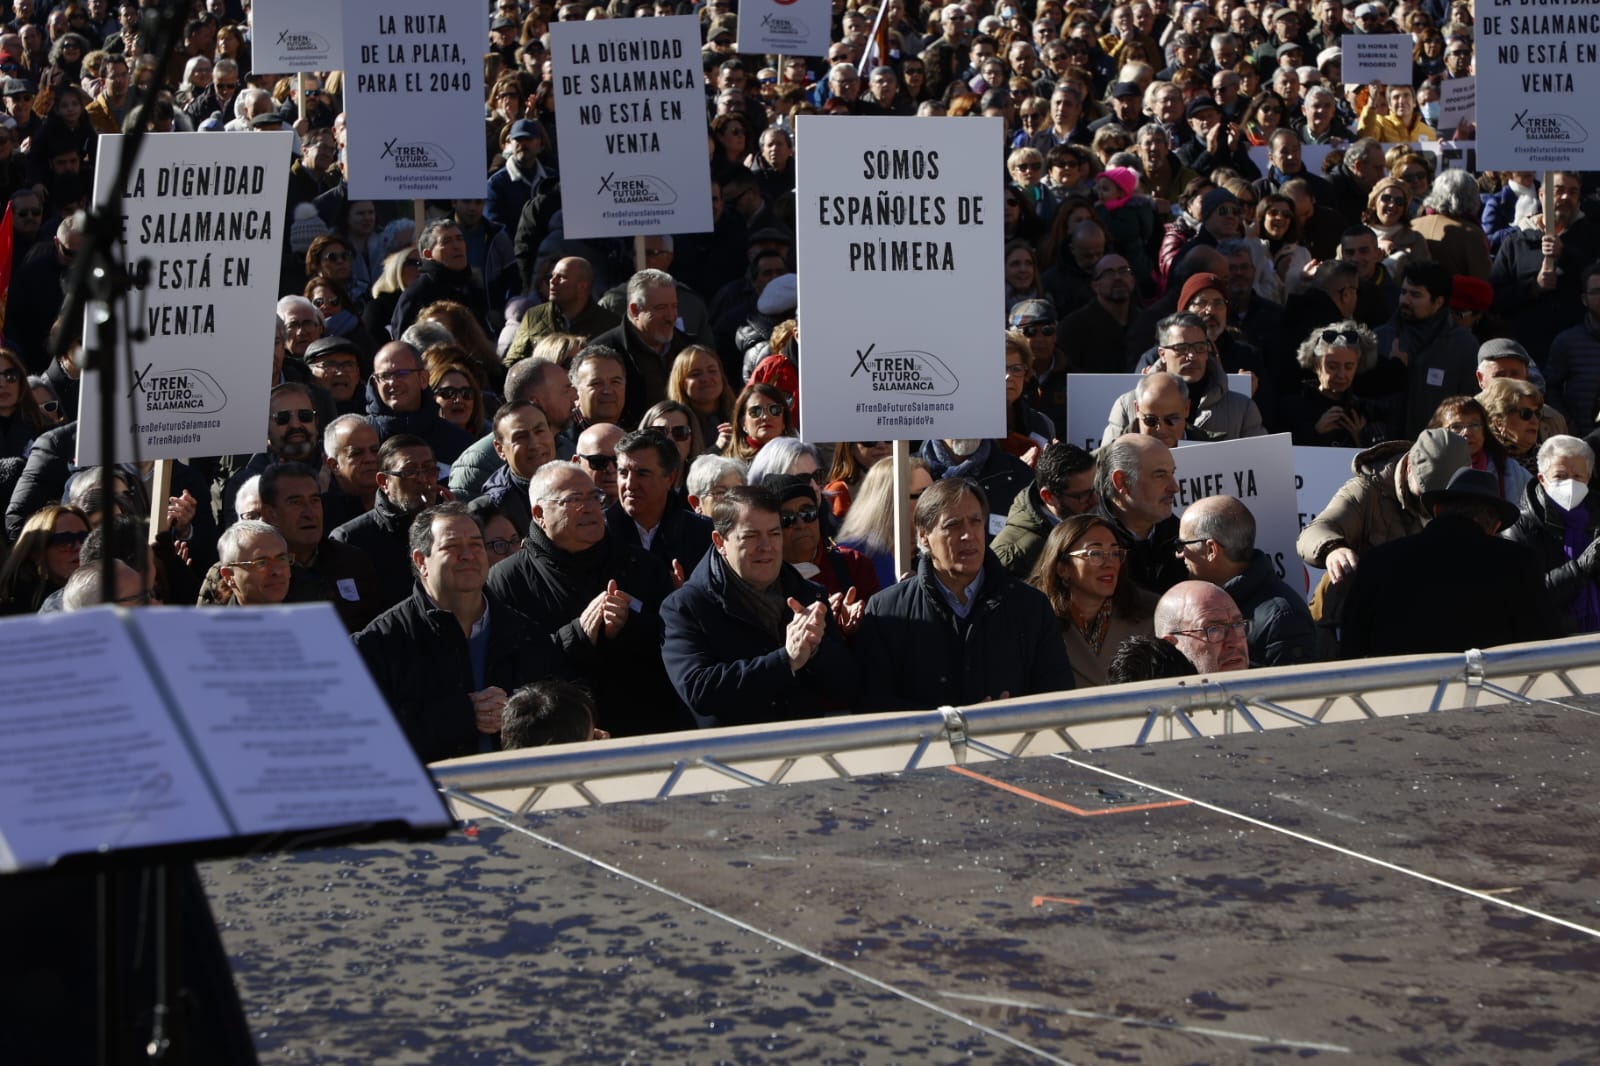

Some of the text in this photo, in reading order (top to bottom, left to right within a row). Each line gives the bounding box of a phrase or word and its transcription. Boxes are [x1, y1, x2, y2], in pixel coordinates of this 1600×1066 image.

[380, 15, 446, 34] LA RUTA
[1483, 14, 1600, 35] DE SALAMANC
[361, 43, 466, 65] DE LA PLATA,
[572, 39, 682, 64] LA DIGNIDAD
[1498, 41, 1596, 64] NO ESTÁ EN
[358, 72, 471, 92] PARA EL 2040
[562, 69, 694, 95] DE SALAMANCA
[1522, 73, 1574, 92] VENTA
[580, 98, 681, 124] NO ESTÁ EN
[1528, 118, 1556, 126] TREN
[396, 147, 424, 155] TREN
[605, 132, 660, 154] VENTA
[863, 150, 939, 180] SOMOS
[157, 165, 265, 197] DIGNIDAD
[614, 180, 644, 190] TREN
[613, 189, 648, 198] FUTURO
[614, 196, 660, 204] SALAMANCA
[819, 190, 984, 226] ESPAÑOLES DE
[140, 210, 271, 244] SALAMANCA
[849, 240, 954, 271] PRIMERA
[158, 253, 211, 290] ESTÁ
[223, 257, 250, 286] EN
[149, 304, 215, 336] VENTA
[874, 358, 914, 371] TREN
[150, 376, 188, 390] TREN
[872, 372, 920, 382] FUTURO
[872, 382, 934, 391] SALAMANCA
[146, 390, 192, 402] FUTURO
[146, 400, 204, 411] SALAMANCA
[856, 402, 954, 413] #TrenDeFuturoSalamanca
[1172, 473, 1223, 508] ENFE
[1233, 469, 1258, 498] YA
